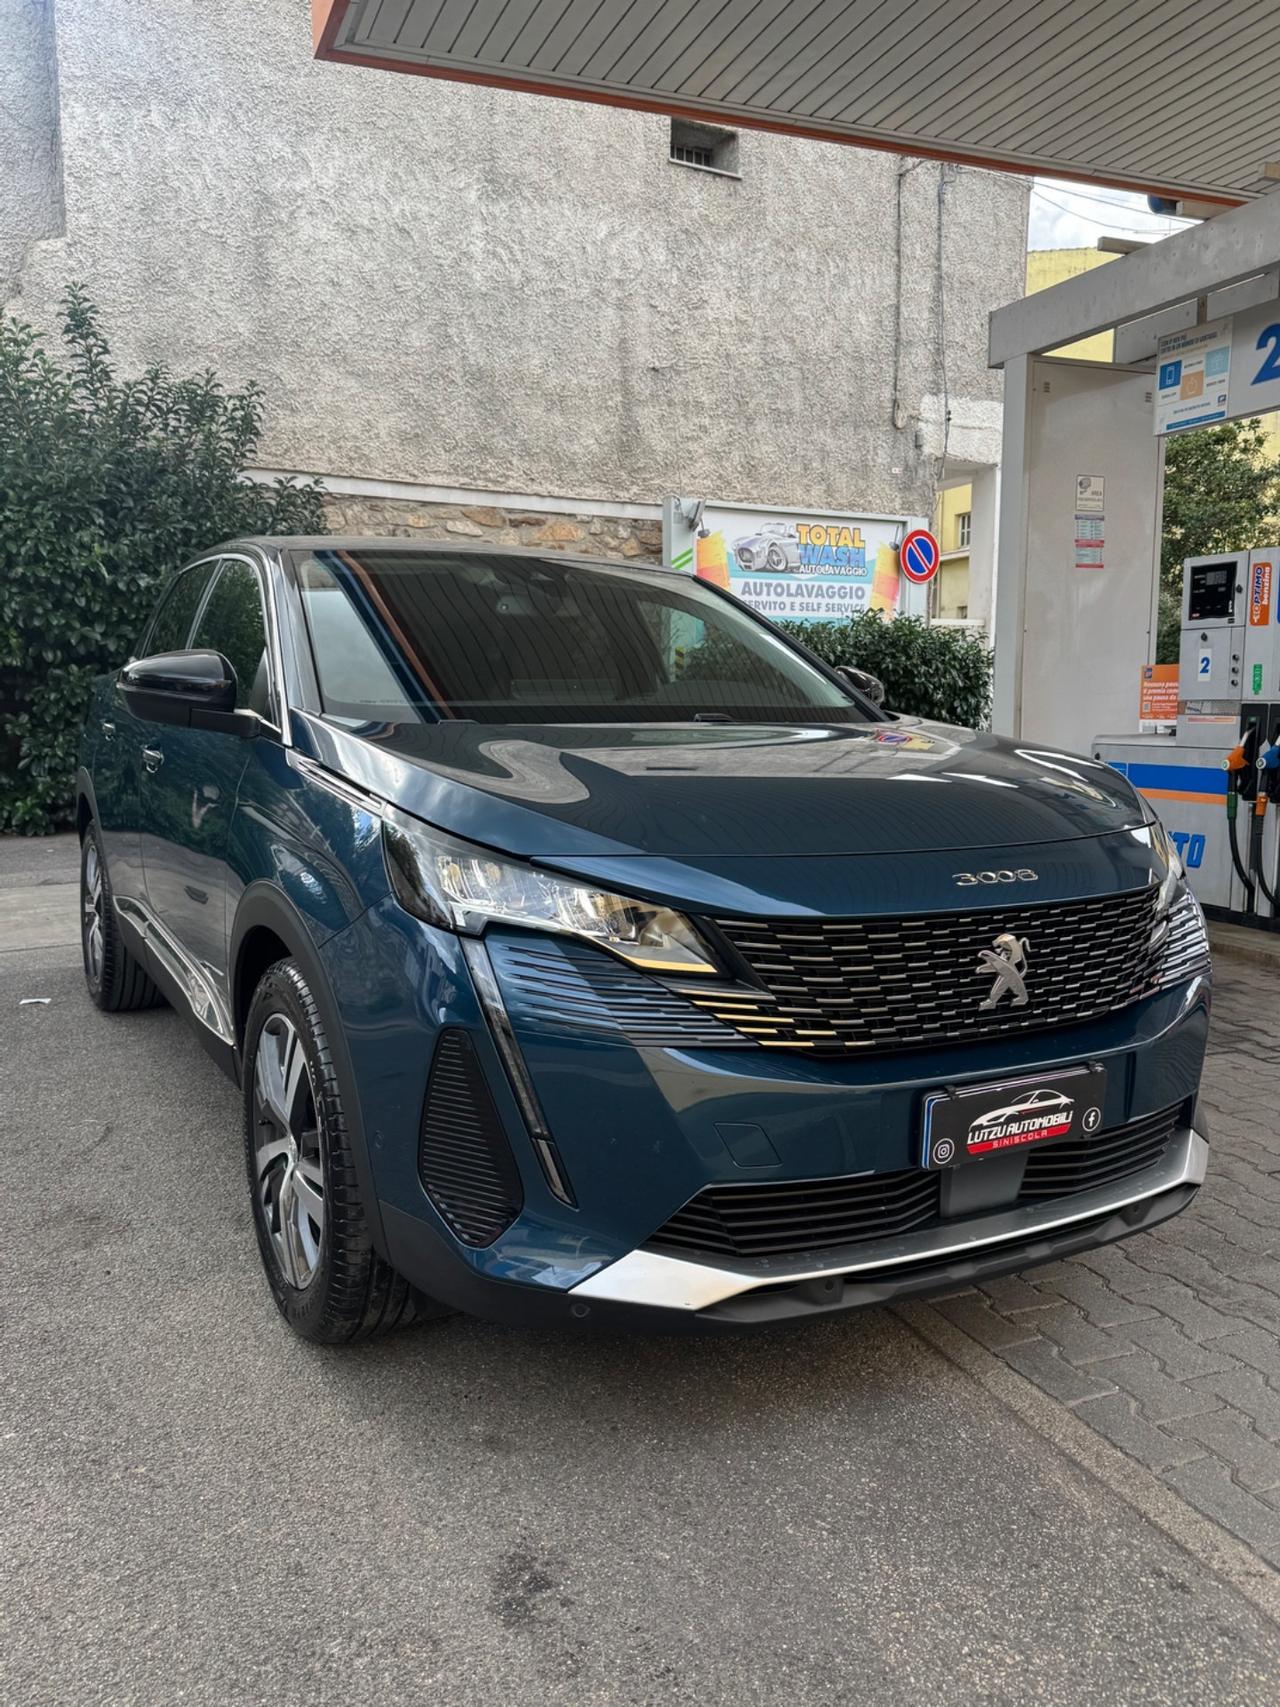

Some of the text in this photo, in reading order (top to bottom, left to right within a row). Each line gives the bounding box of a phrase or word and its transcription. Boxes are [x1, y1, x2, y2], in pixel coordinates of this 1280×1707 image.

[1250, 322, 1280, 386] 2
[796, 524, 865, 548] TOTAL
[797, 544, 866, 567] WASH
[800, 564, 868, 576] AUTOLAVAGGIO
[741, 581, 866, 600] AUTOLAVAGGIO
[790, 601, 796, 612] E
[799, 601, 822, 613] SELF
[1200, 656, 1211, 674] 2
[952, 868, 1039, 886] 3008
[967, 1110, 1074, 1144] LUTZU AUTOMOBILI
[992, 1129, 1048, 1149] SINISCOLA
